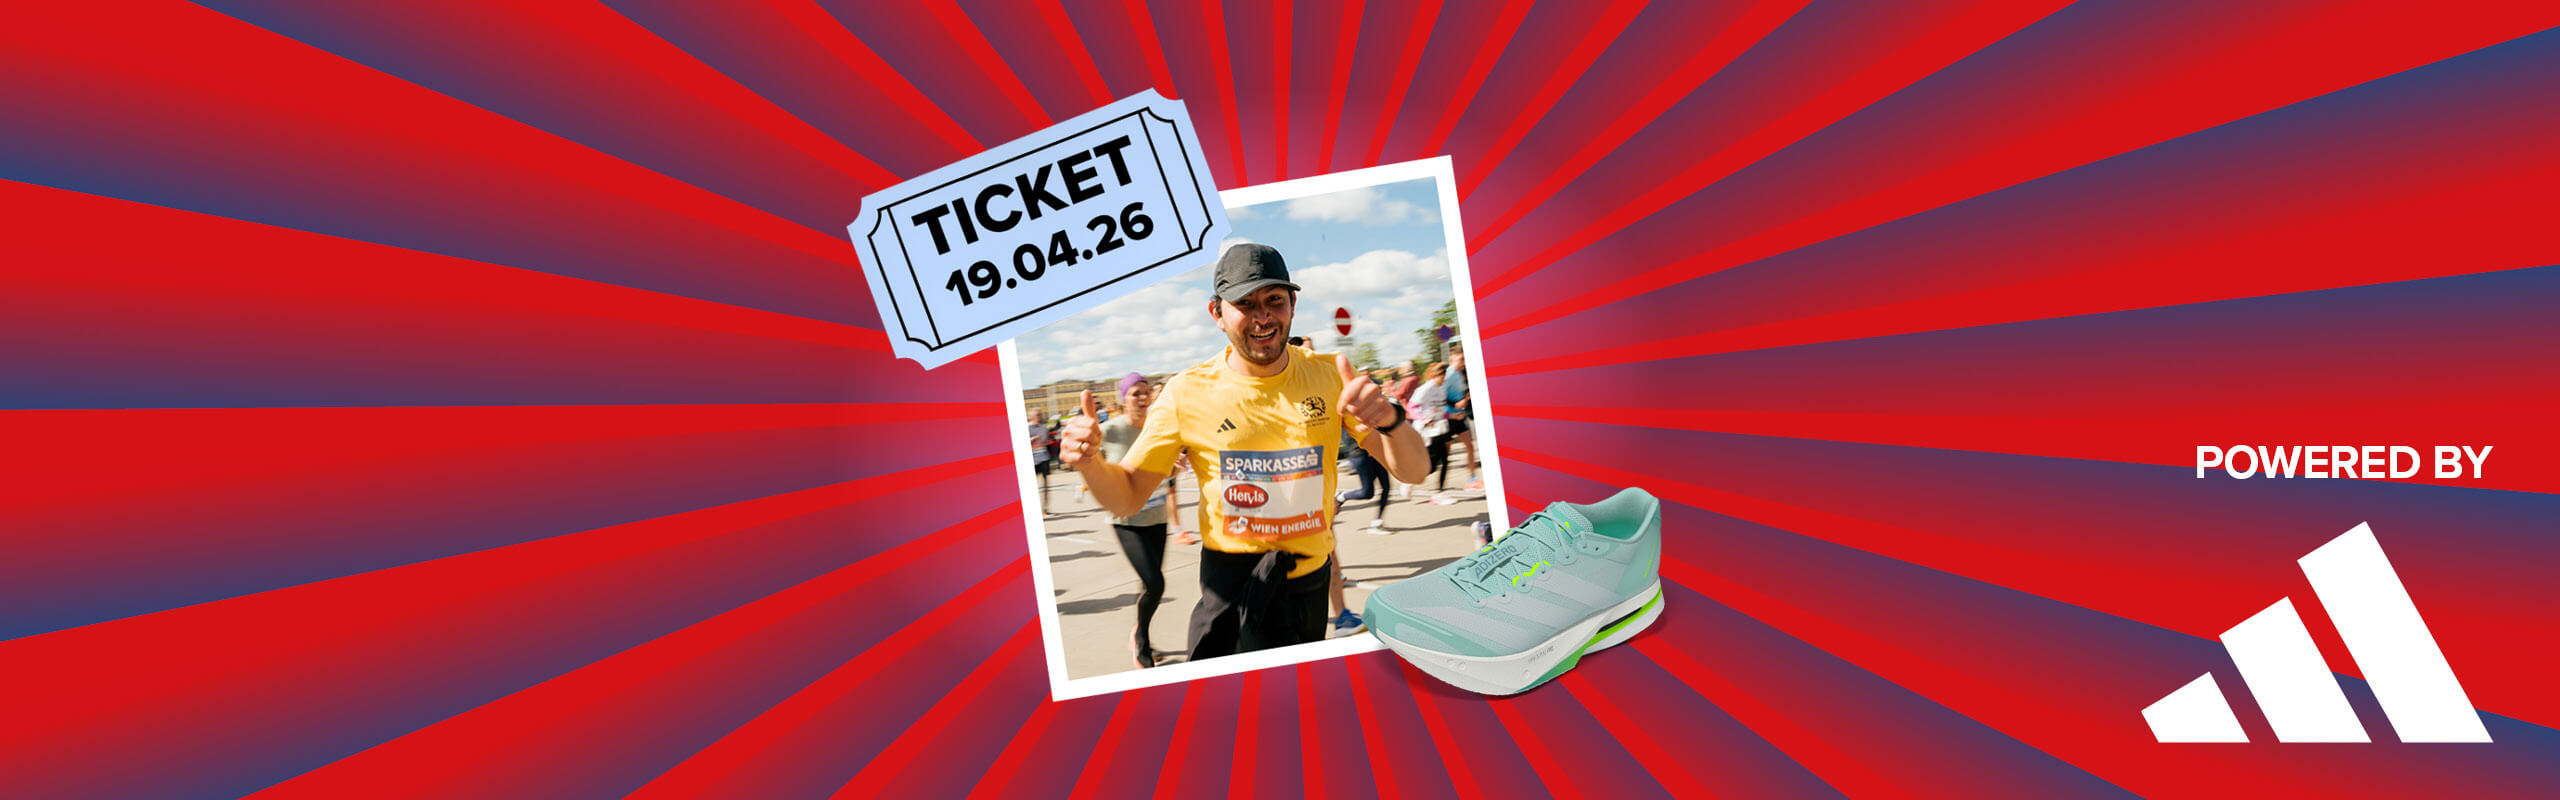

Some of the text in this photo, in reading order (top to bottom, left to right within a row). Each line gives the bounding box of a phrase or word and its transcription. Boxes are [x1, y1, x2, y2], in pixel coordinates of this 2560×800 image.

[1225, 456, 1305, 472] SPARKASSE
[1251, 518, 1321, 534] WIEN ENERGIE
[1475, 545, 1517, 580] ADIZERO
